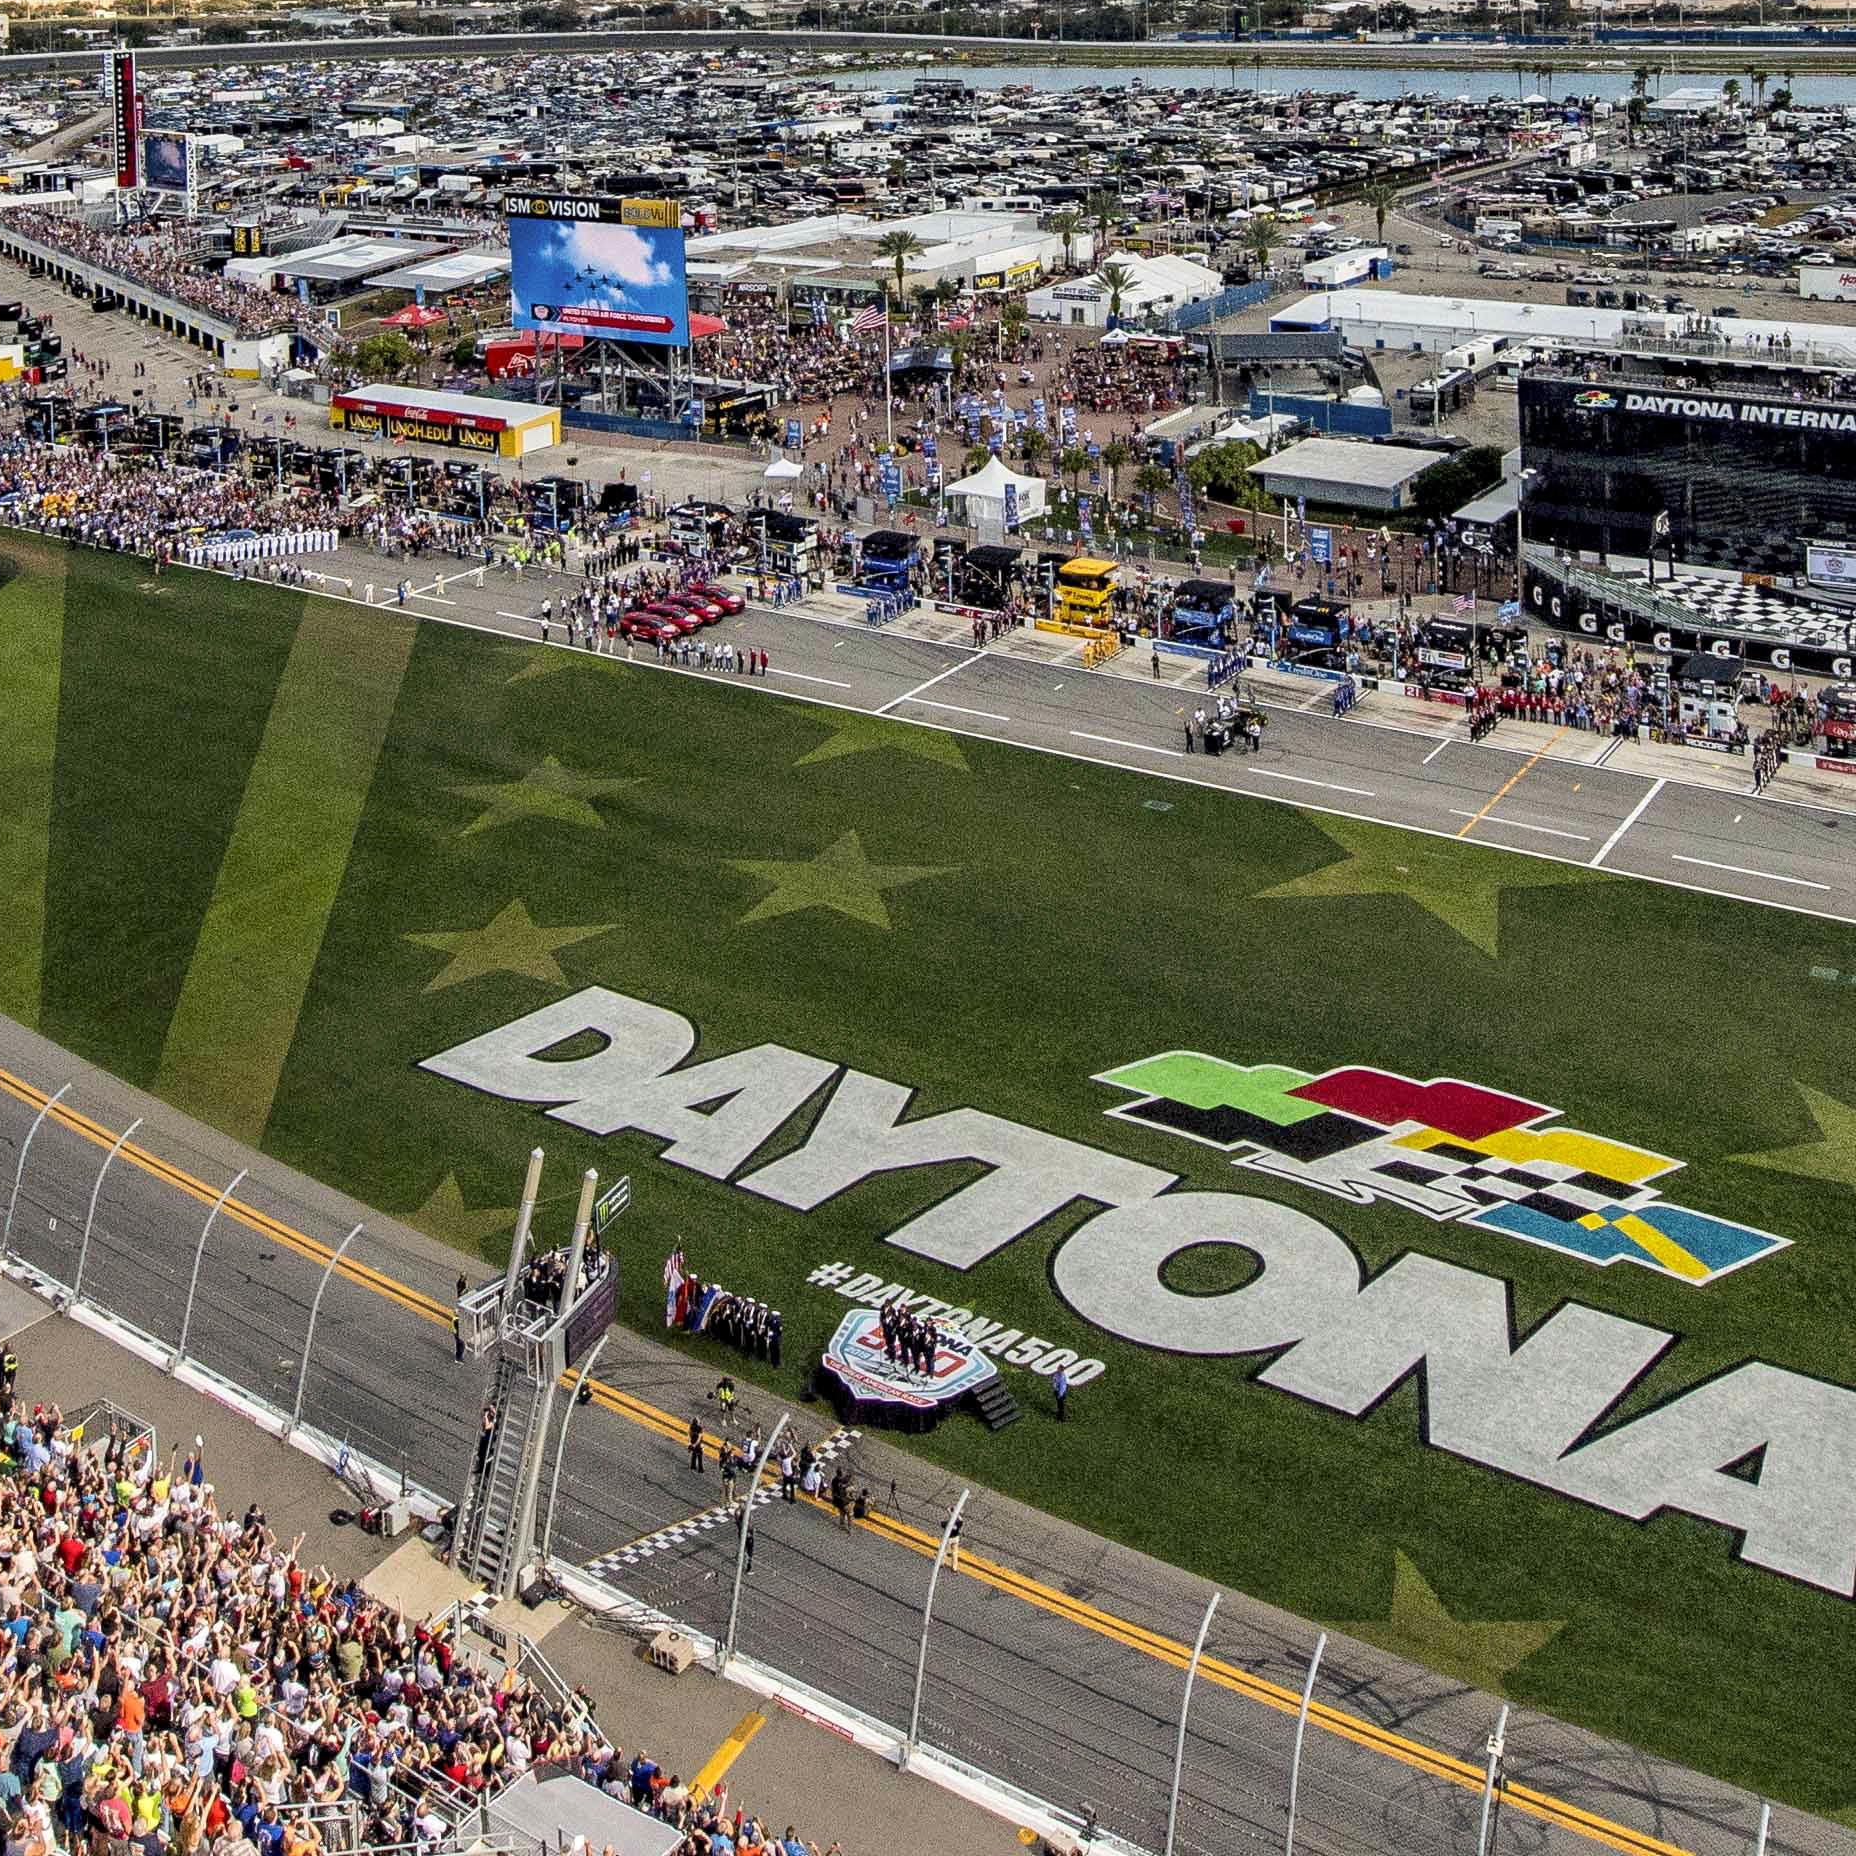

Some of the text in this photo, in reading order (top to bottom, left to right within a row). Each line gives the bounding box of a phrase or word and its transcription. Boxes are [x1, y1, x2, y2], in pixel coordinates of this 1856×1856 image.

[505, 197, 600, 218] ISM VISION
[1625, 394, 1734, 421] DAYTONA
[349, 412, 382, 430] UNOH
[390, 420, 450, 442] UNOH.EDU
[458, 429, 494, 446] UNOH
[1461, 531, 1474, 545] G
[1532, 585, 1543, 606] G
[1551, 597, 1561, 617] G
[1579, 613, 1598, 633] G
[1607, 622, 1625, 642] G
[1653, 632, 1672, 651] G
[1770, 649, 1791, 669] G
[1832, 657, 1852, 677] G
[1405, 686, 1419, 697] 21
